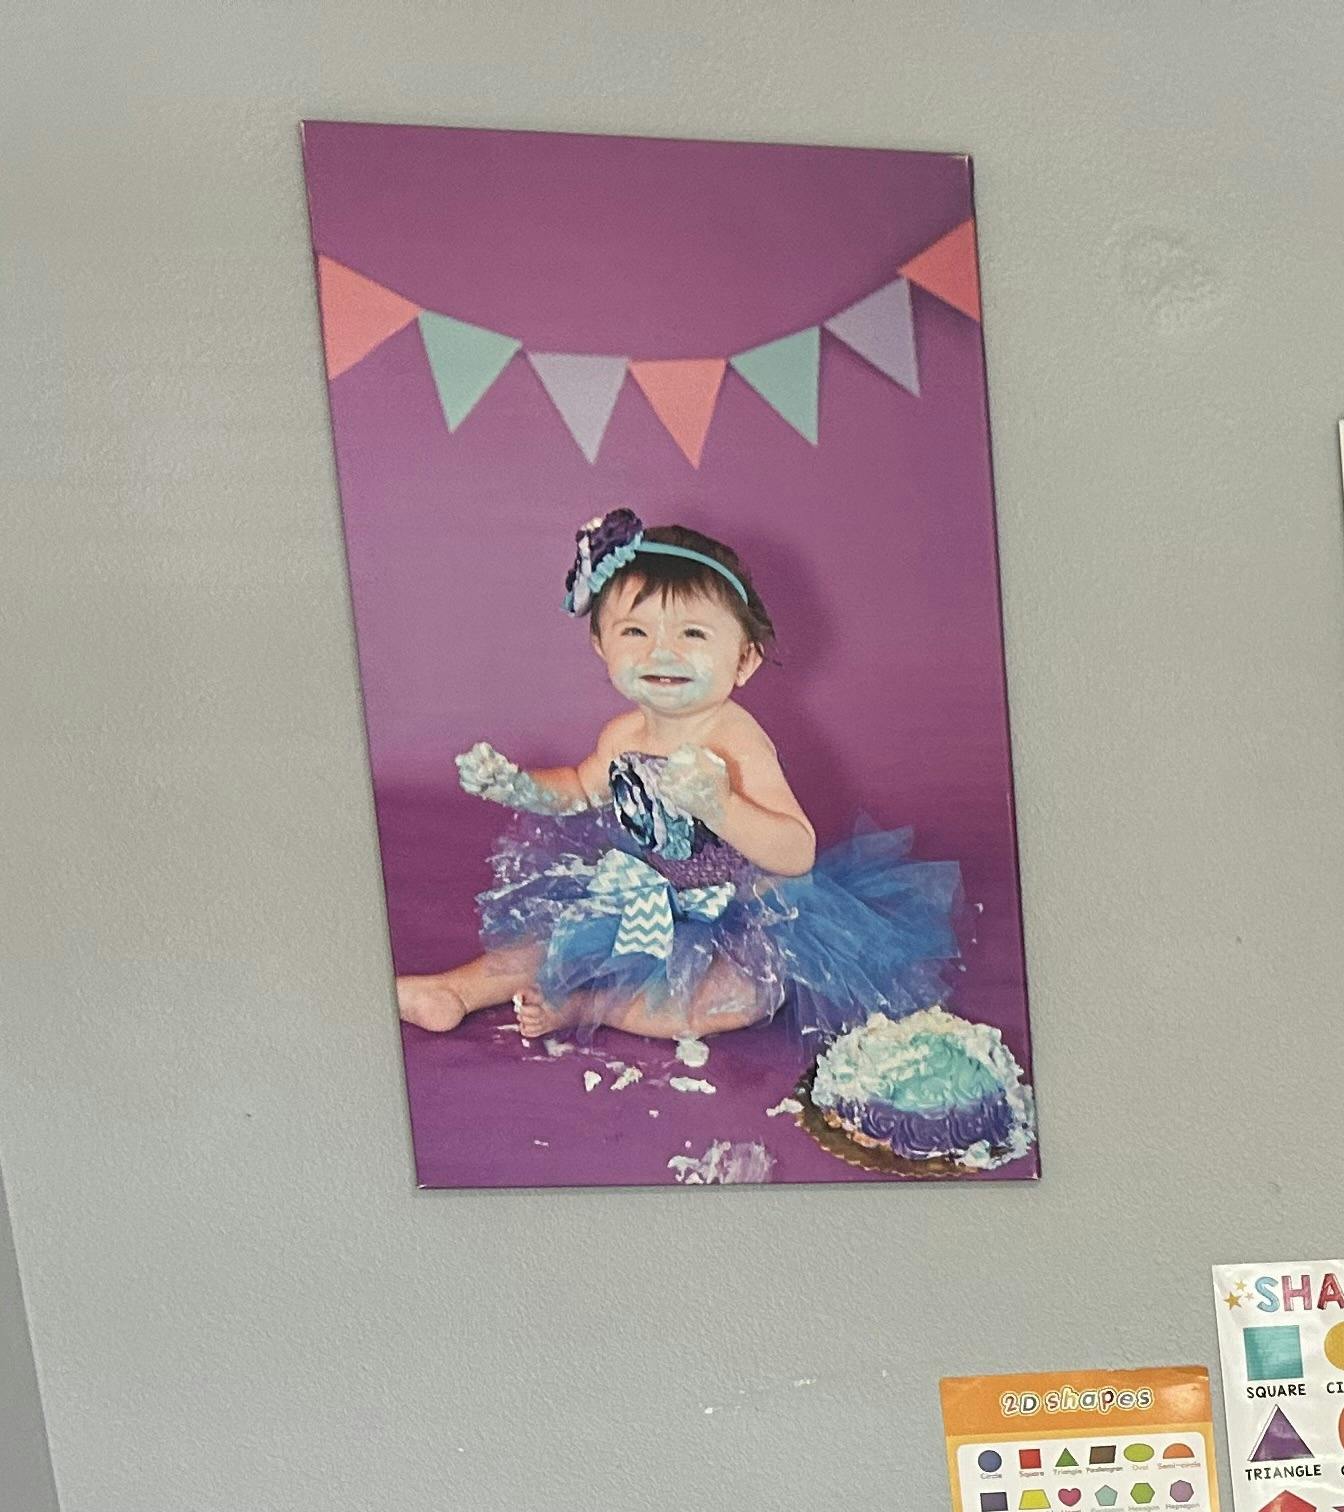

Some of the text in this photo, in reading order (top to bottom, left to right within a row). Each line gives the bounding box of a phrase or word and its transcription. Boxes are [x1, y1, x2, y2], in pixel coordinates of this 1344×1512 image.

[1247, 1383, 1307, 1398] SQUARE
[1002, 1387, 1152, 1415] 2D shapes
[1245, 1465, 1322, 1481] TRIANGLE
